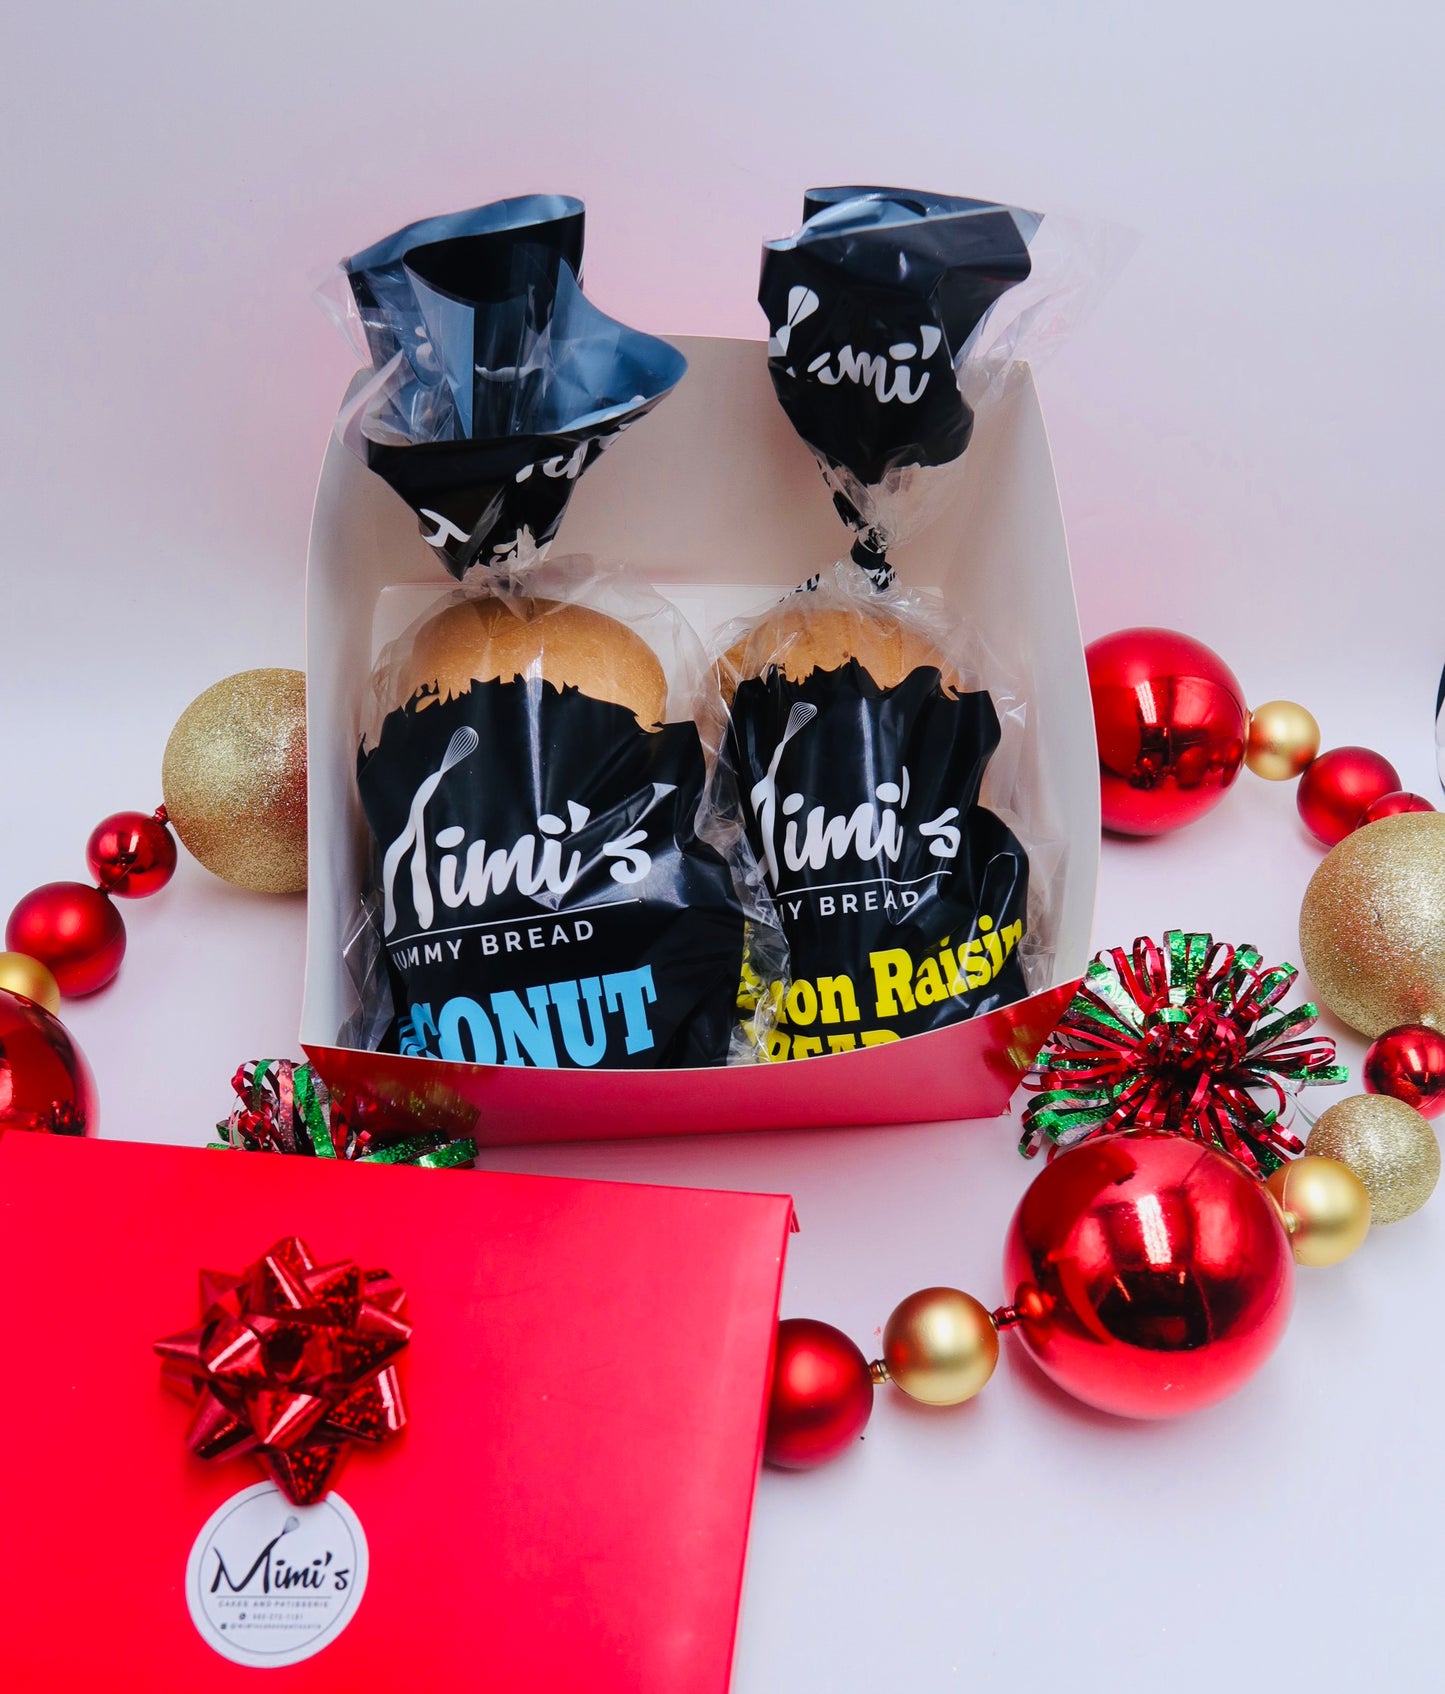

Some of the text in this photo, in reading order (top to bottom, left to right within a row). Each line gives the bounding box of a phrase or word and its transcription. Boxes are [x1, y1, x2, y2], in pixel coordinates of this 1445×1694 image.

[820, 890, 920, 917] BREAD
[481, 919, 595, 956] BREAD
[210, 1535, 350, 1594] Mimi's
